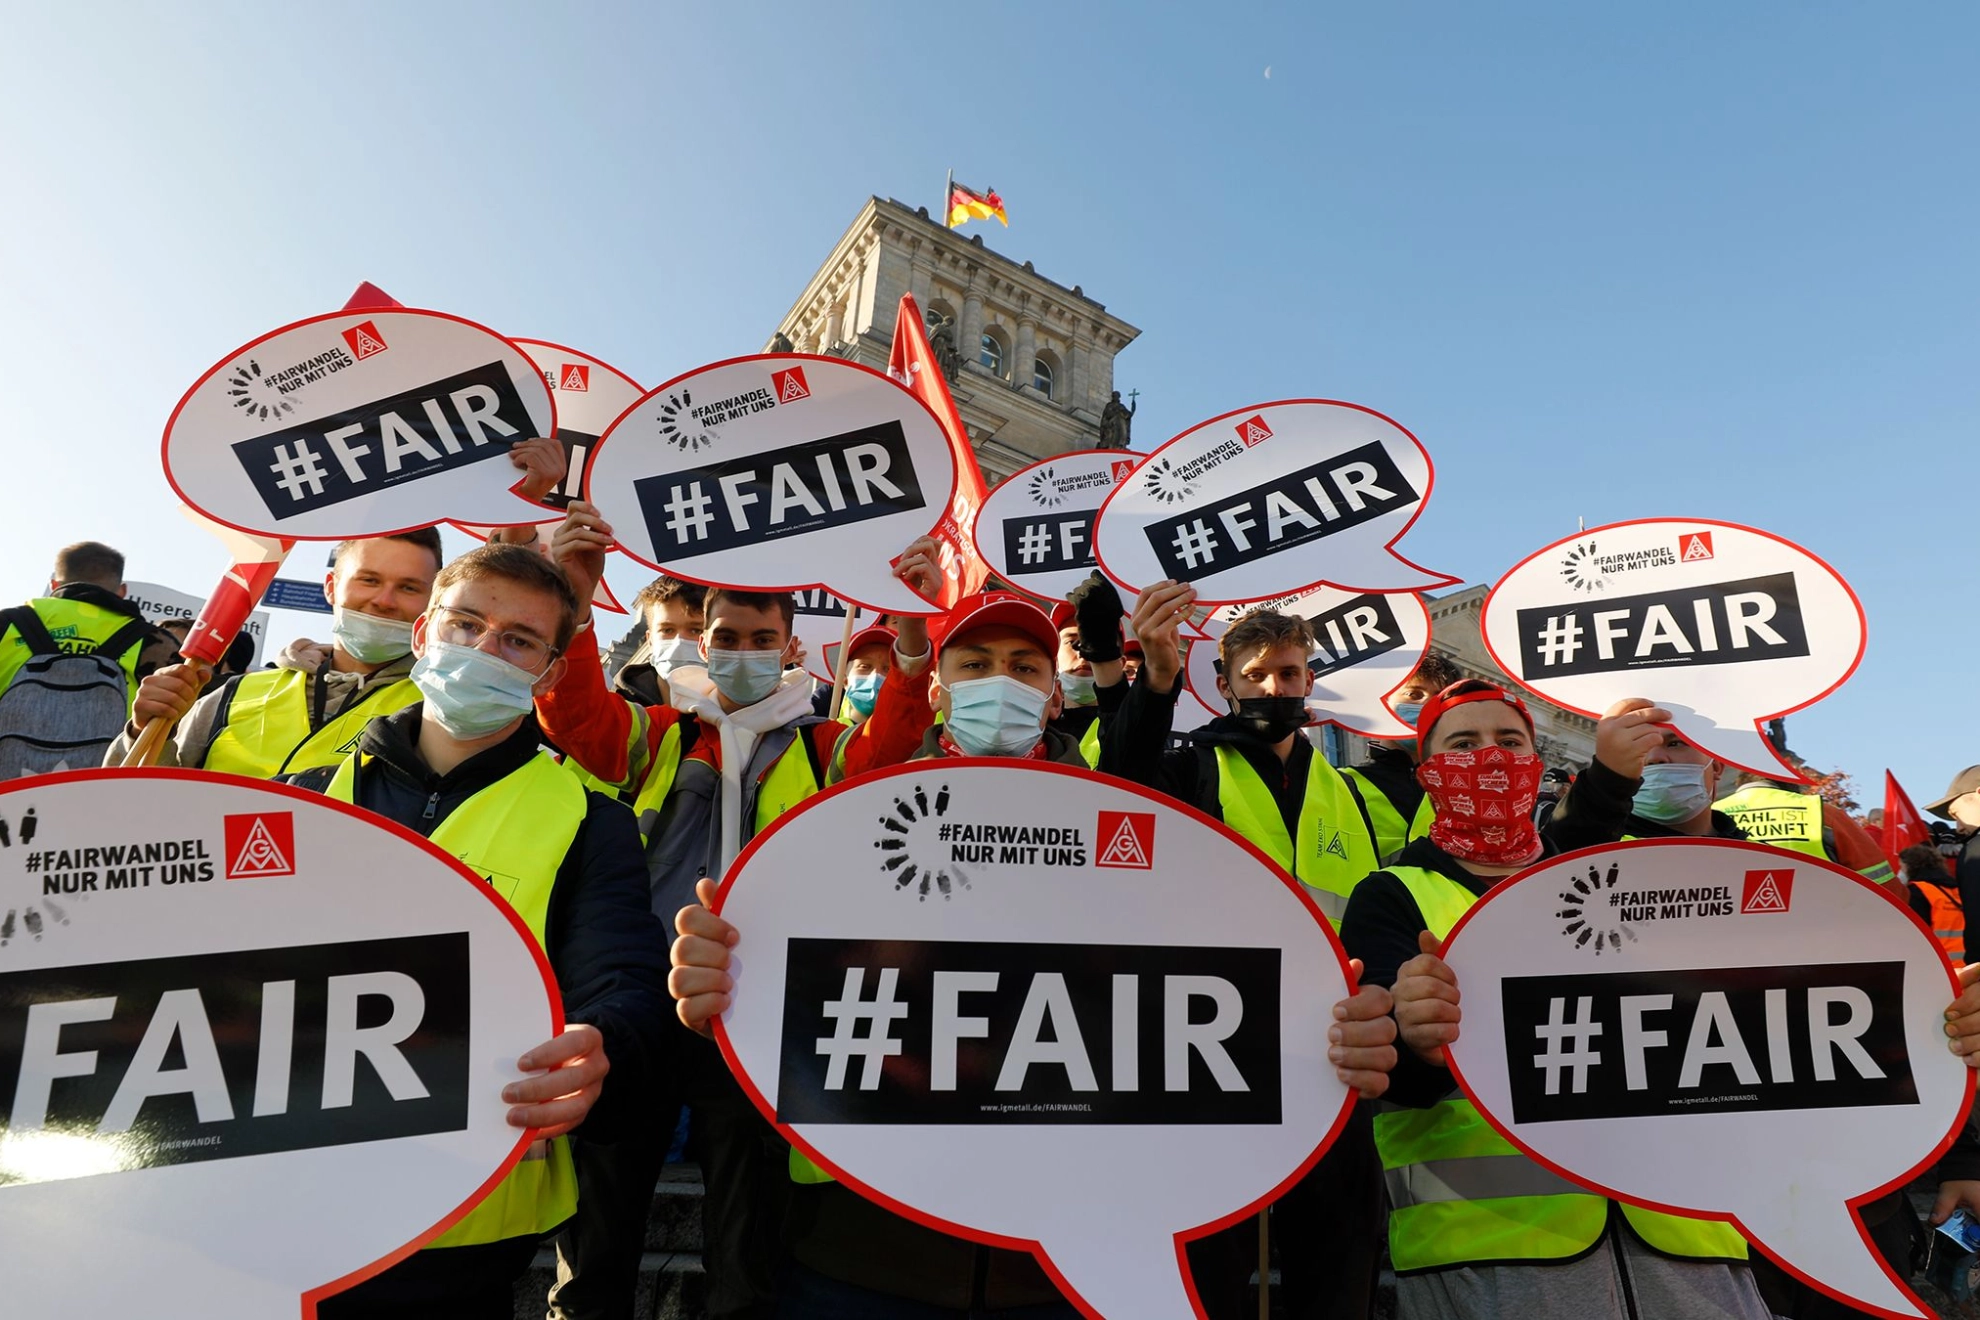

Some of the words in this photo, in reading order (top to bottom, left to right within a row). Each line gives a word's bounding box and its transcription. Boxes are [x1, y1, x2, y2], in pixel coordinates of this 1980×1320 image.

[264, 347, 346, 388] #FAIRWANDEL
[277, 377, 305, 395] NUR
[304, 367, 327, 384] MIT
[327, 355, 353, 373] UNS
[691, 388, 770, 420] #FAIRWANDEL
[701, 412, 727, 428] NUR
[728, 405, 749, 421] MIT
[751, 397, 775, 413] UNS
[269, 383, 520, 501] #FAIR
[1172, 439, 1238, 478] #FAIRWANDEL
[1182, 467, 1204, 482] NUR
[1203, 457, 1222, 471] MIT
[1222, 445, 1244, 461] UNS
[663, 442, 905, 545] #FAIR
[1052, 471, 1108, 487] #FAIRWANDEL
[1058, 484, 1075, 493] NUR
[1077, 481, 1091, 490] MIT
[1094, 477, 1111, 487] UNS
[1171, 460, 1397, 570] #FAIR
[1594, 546, 1673, 566] #FAIRWANDEL
[1601, 563, 1625, 574] NUR
[1627, 559, 1648, 571] MIT
[1651, 555, 1676, 567] UNS
[1537, 591, 1787, 667] #FAIR
[1730, 811, 1777, 823] TAHL
[1781, 810, 1808, 821] IST
[1742, 823, 1808, 837] KUNFT
[938, 823, 1084, 847] #FAIRWANDEL
[26, 839, 210, 873] #FAIRWANDEL
[951, 844, 997, 864] NUR
[999, 846, 1038, 865] MIT
[1043, 848, 1086, 867] UNS
[42, 868, 98, 895] NUR
[105, 866, 156, 889] MIT
[161, 861, 214, 885] UNS
[1609, 887, 1732, 908] #FAIRWANDEL
[1620, 906, 1656, 923] NUR
[1659, 904, 1693, 920] MIT
[1697, 901, 1733, 917] UNS
[816, 966, 1251, 1091] #FAIR
[1533, 985, 1887, 1095] #FAIR
[980, 1104, 1092, 1113] www.igmetall.de/FAIRWANDEL
[1668, 1094, 1758, 1105] www.igmetall.de/FAIRWANDEL
